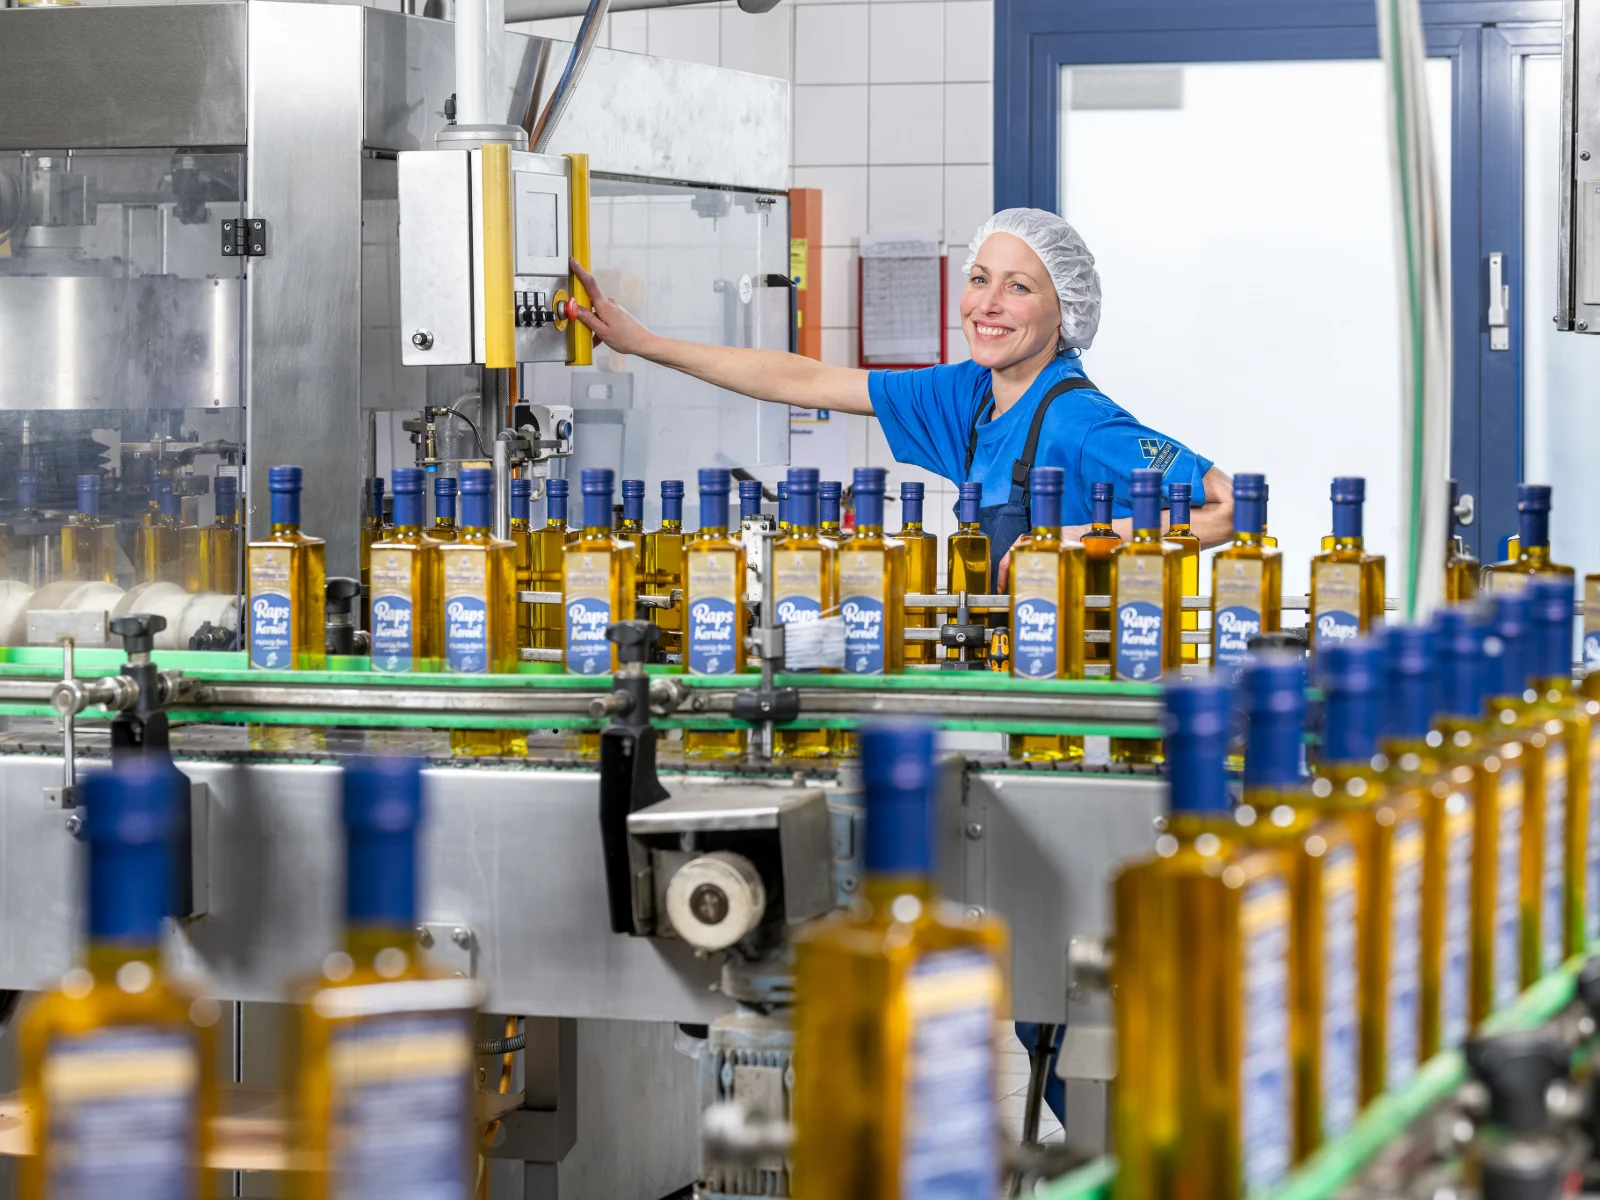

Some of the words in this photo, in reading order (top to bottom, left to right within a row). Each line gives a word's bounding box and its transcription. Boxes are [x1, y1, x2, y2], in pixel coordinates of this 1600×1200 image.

[253, 598, 290, 625] Raps
[374, 601, 411, 627] Raps
[447, 601, 485, 628] Raps
[568, 603, 609, 630] Raps
[692, 603, 734, 629] Raps
[842, 602, 882, 629] Raps
[1017, 603, 1056, 630] Raps
[1120, 607, 1161, 634] Raps
[1218, 611, 1259, 639] Raps
[694, 625, 731, 641] Kernöl
[1122, 630, 1157, 646] Kernöl
[1318, 615, 1358, 644] Raps
